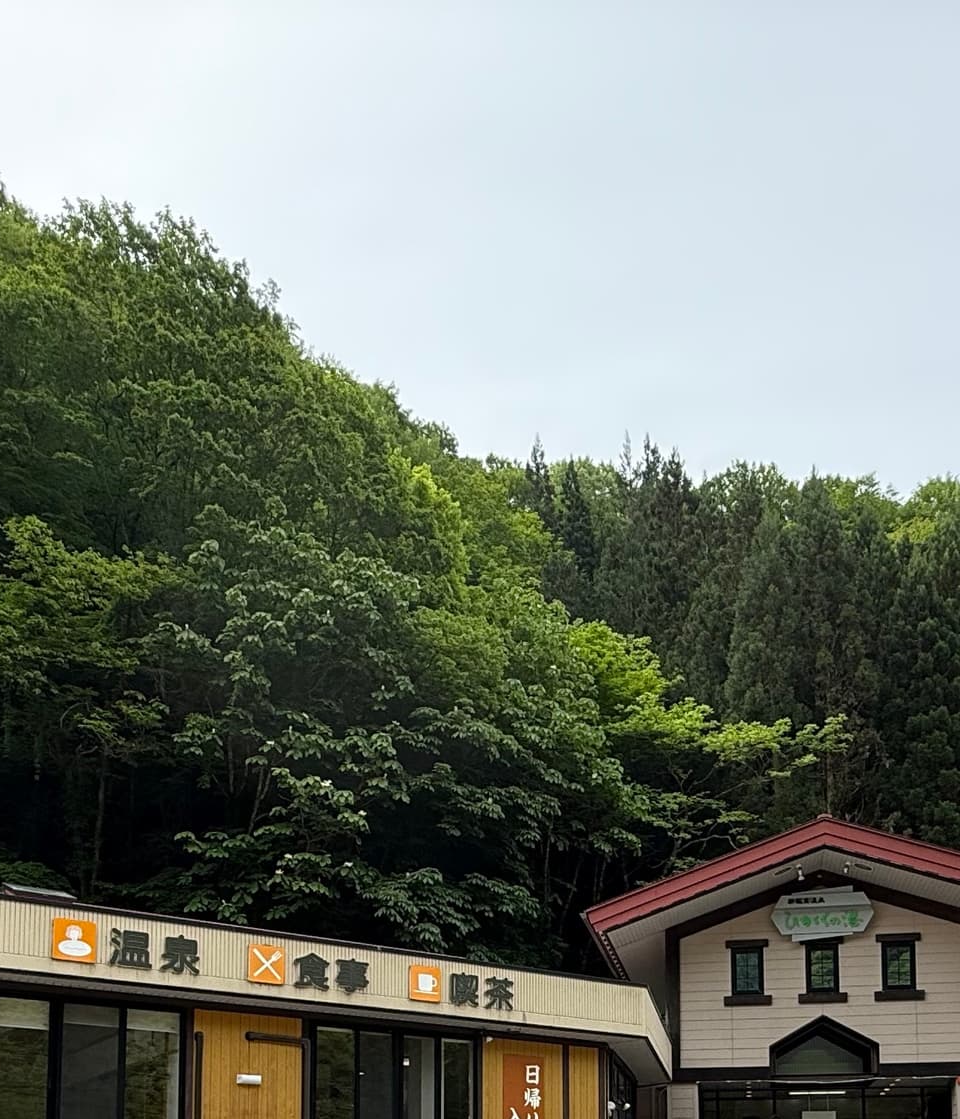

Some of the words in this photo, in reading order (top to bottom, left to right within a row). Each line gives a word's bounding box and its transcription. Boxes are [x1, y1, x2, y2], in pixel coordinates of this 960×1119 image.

[110, 927, 200, 976] 温泉
[293, 952, 370, 995] 食事
[449, 972, 514, 1011] 喫茶
